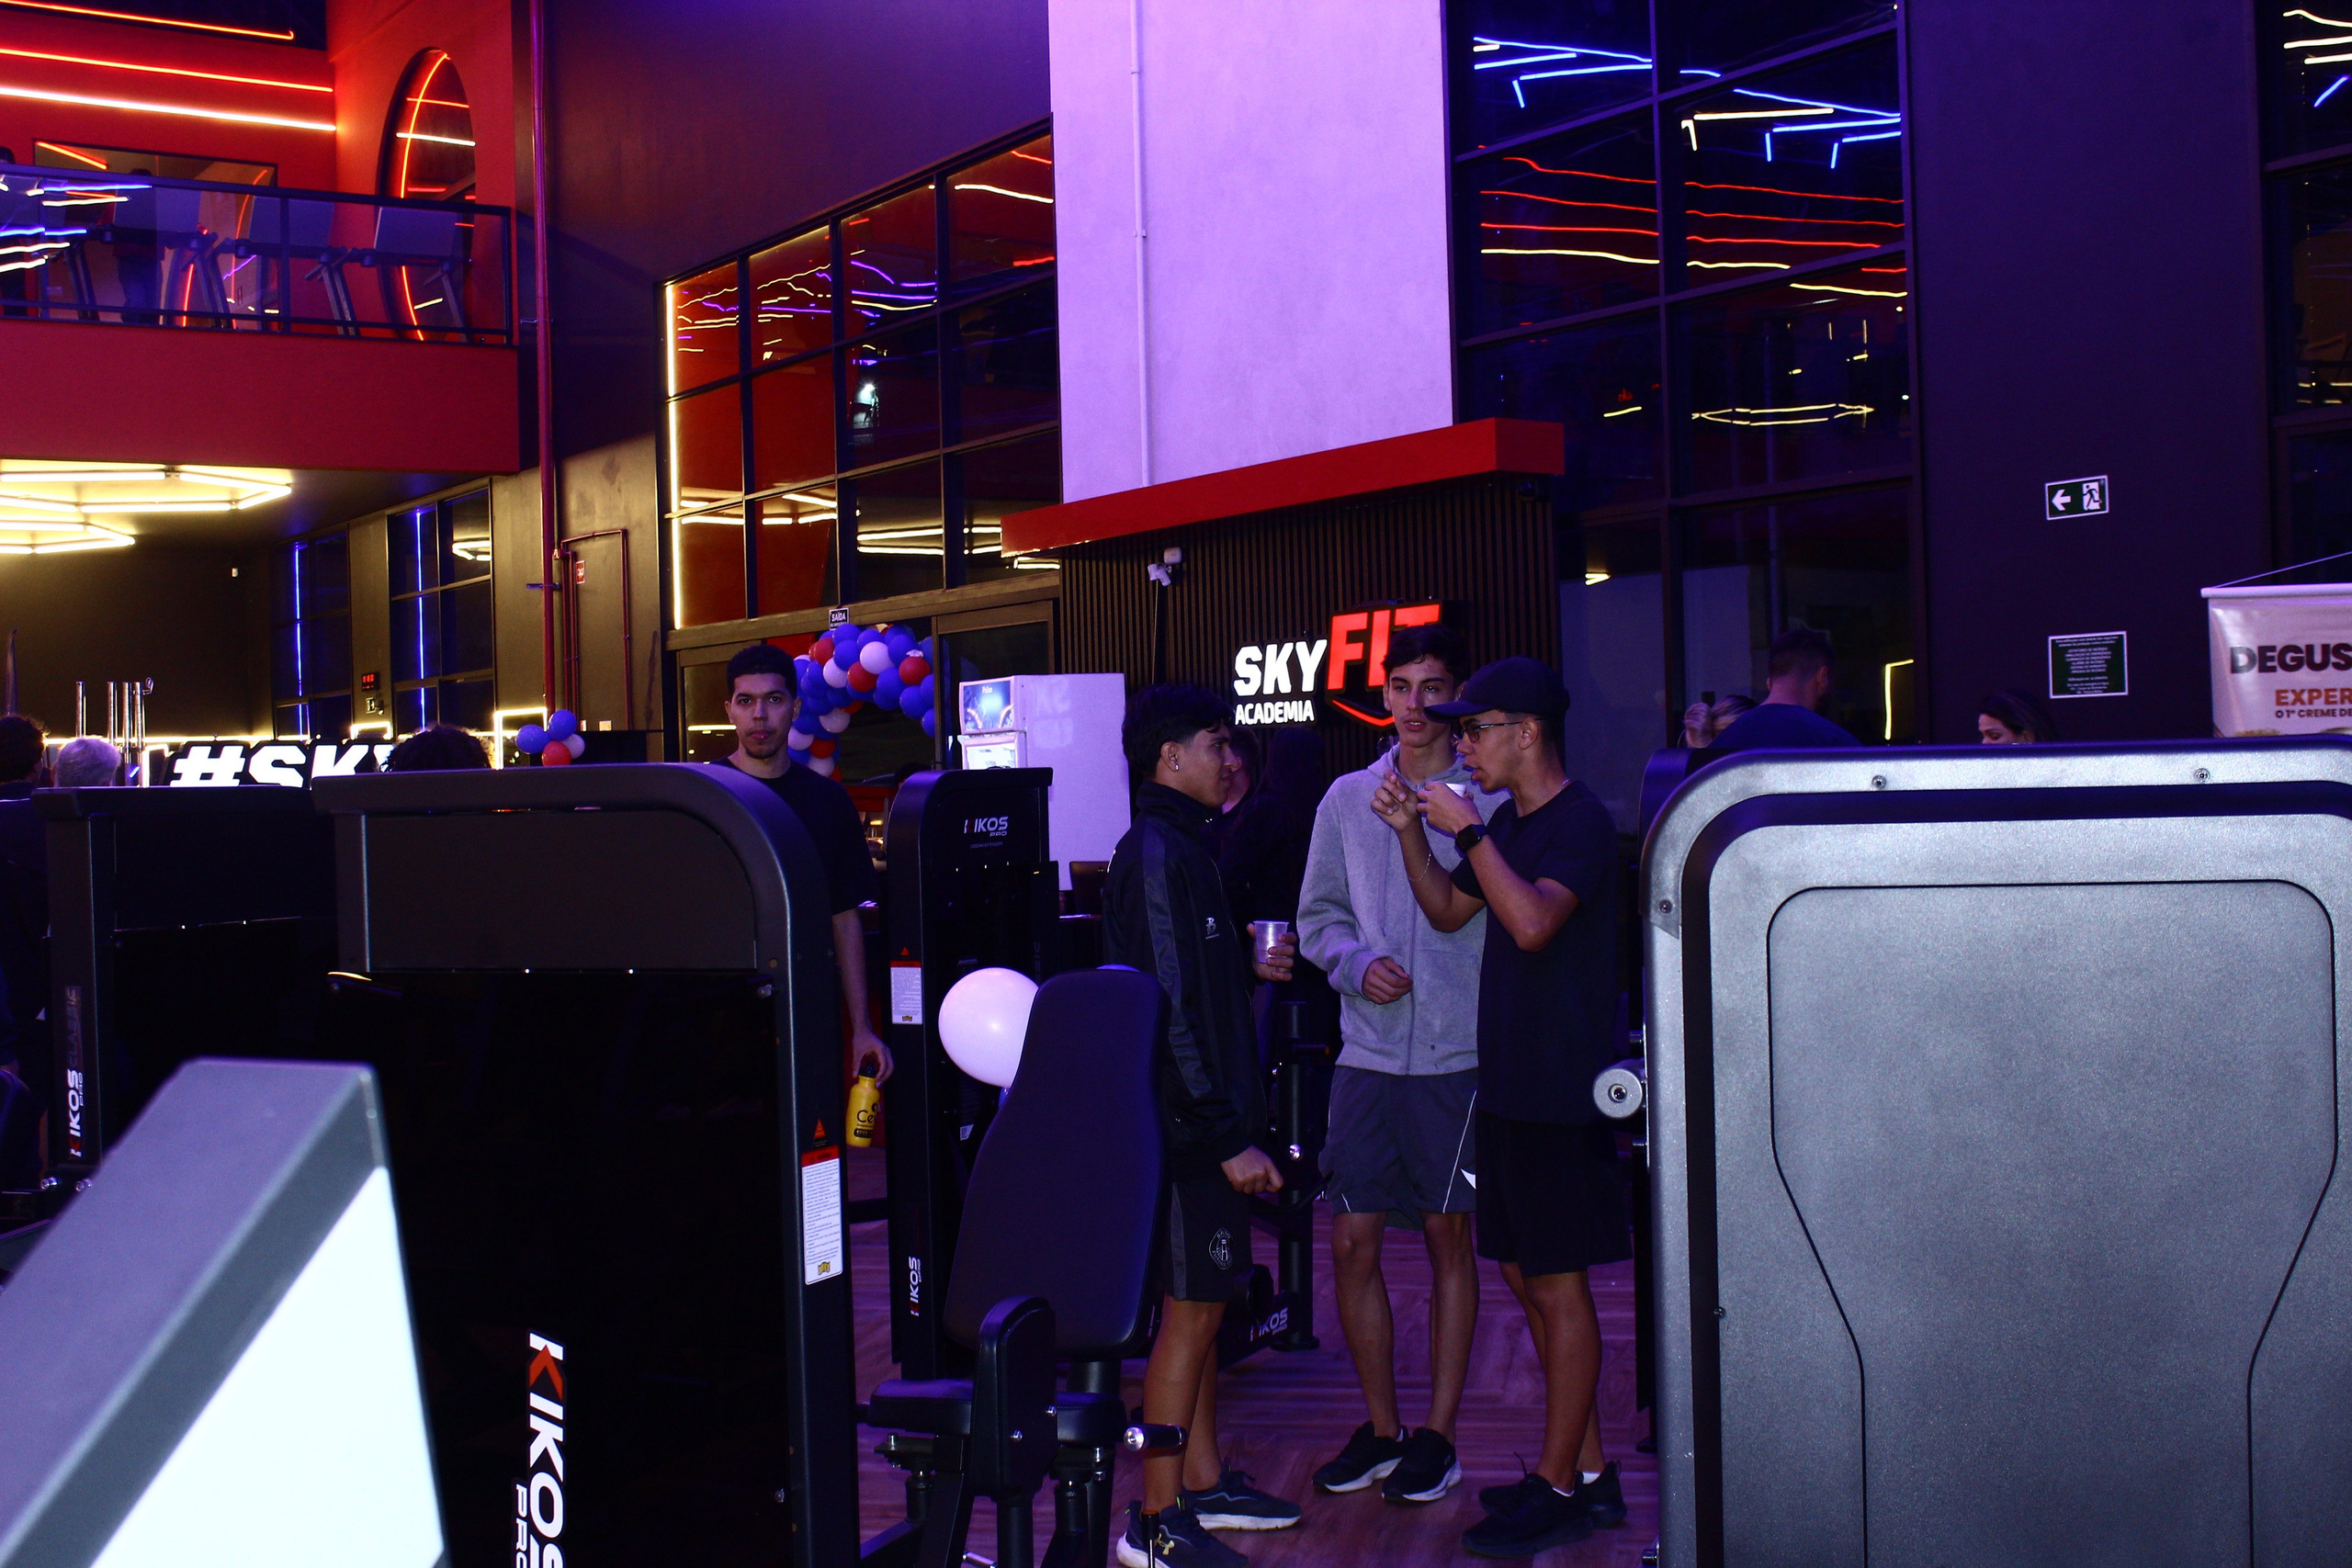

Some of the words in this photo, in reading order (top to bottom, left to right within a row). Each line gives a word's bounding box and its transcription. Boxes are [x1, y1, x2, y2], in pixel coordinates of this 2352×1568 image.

[1234, 639, 1328, 696] SKY
[2231, 643, 2352, 674] DEGUS
[2275, 688, 2352, 706] EXPER
[1235, 700, 1315, 726] ACADEMIA
[2298, 708, 2337, 717] CREME
[964, 816, 1009, 834] KIKOS
[67, 1068, 83, 1158] KIKOS
[909, 1256, 920, 1317] KIKOS
